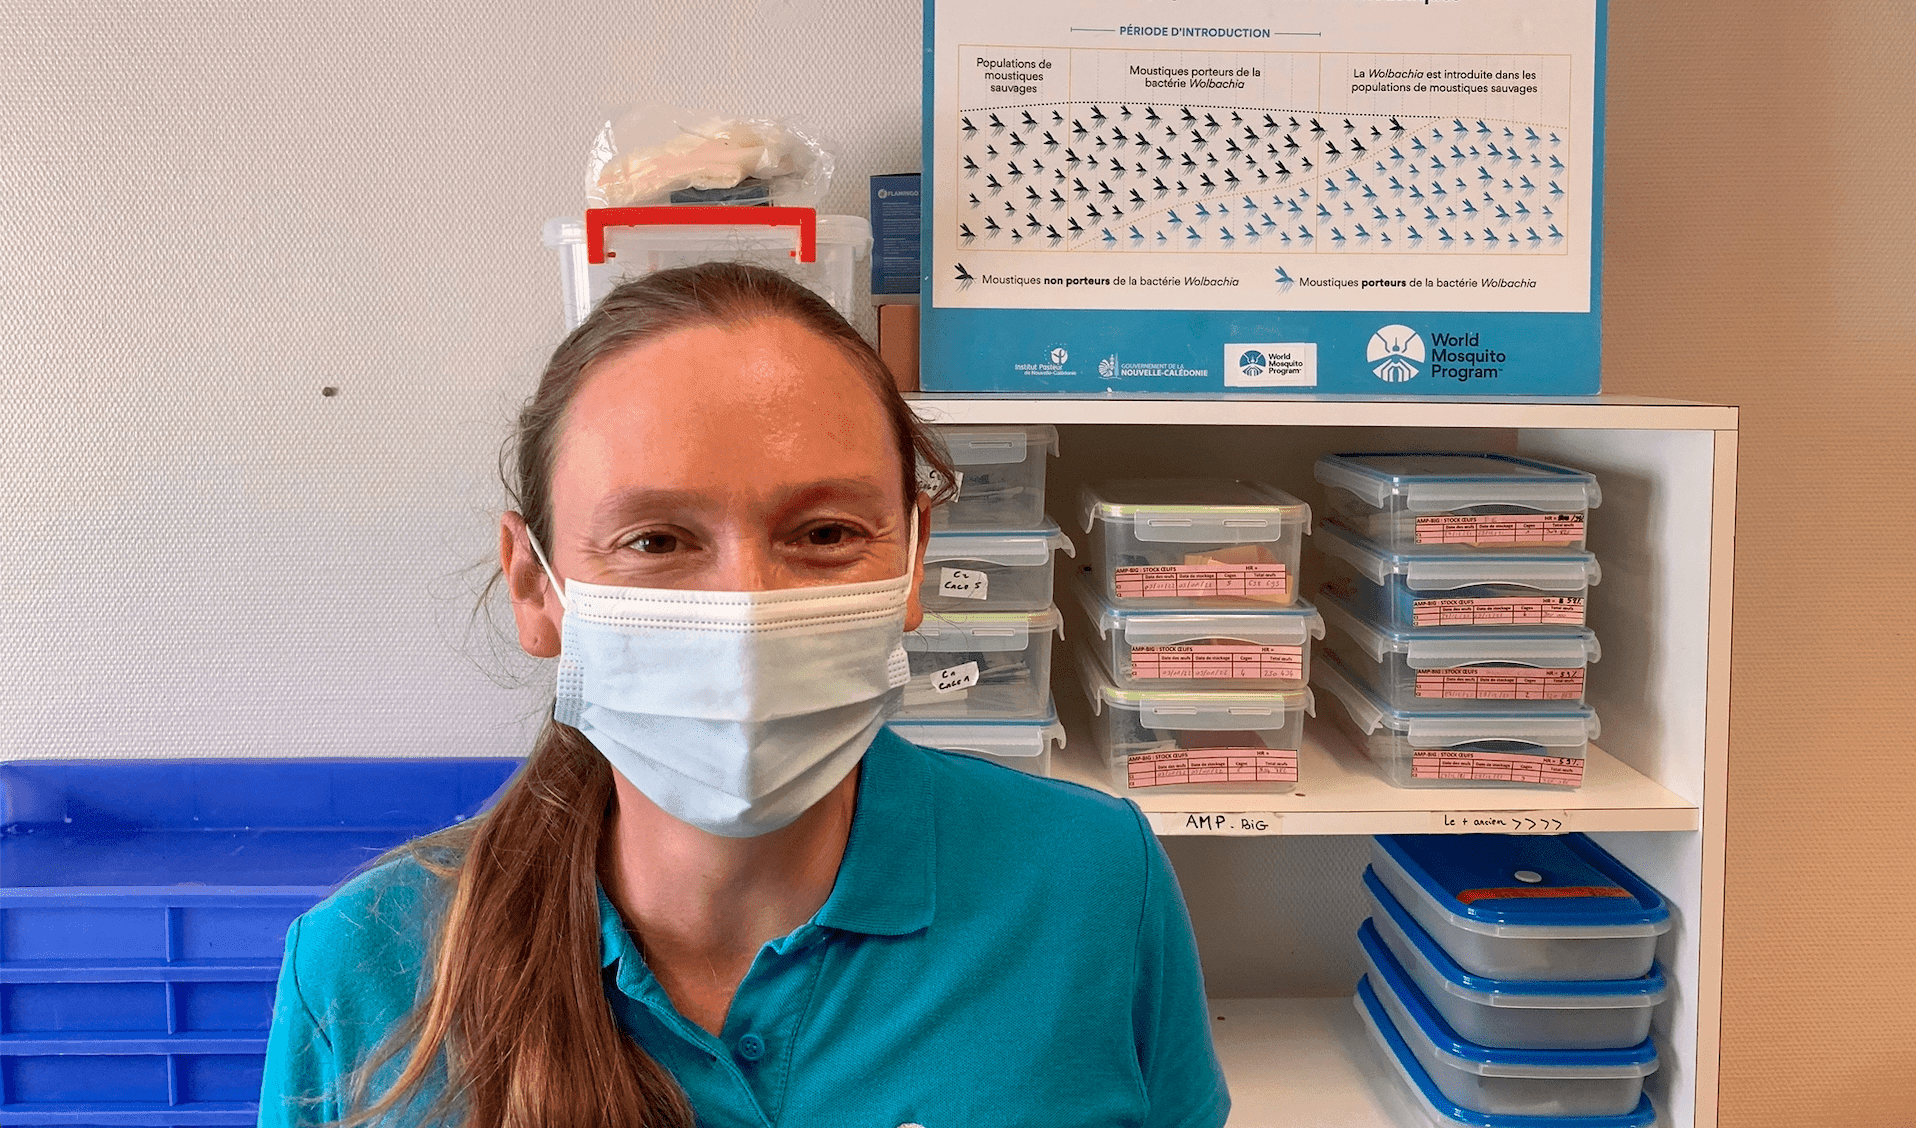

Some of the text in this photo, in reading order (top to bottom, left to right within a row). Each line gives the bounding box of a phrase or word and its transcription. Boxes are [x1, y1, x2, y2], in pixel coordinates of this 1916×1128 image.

[1120, 24, 1270, 38] PÉRIODE D'INTRODUCTION
[976, 58, 1052, 70] Populations de
[985, 71, 1044, 83] moustiques
[1130, 66, 1260, 78] Moustiques porteurs de la
[1353, 69, 1536, 80] La Wolbachia est introduite dans les
[990, 84, 1038, 95] sauvages
[1145, 78, 1245, 89] bactérie Wolbachia
[1351, 82, 1538, 95] populations de moustiques sauvages
[982, 275, 1041, 287] Moustiques
[1066, 278, 1110, 287] porteurs
[1113, 276, 1126, 286] de
[1128, 276, 1137, 286] la
[1140, 276, 1181, 286] bactérie
[1184, 276, 1239, 286] Wolbachia
[1300, 278, 1536, 289] Moustiques porteurs de la bactérie Wolbachia
[1431, 332, 1479, 347] World
[1431, 349, 1506, 365] Mosquito
[1121, 368, 1208, 377] NOUVELLE-CALÉDONIE
[1186, 815, 1225, 830] AMP
[1445, 814, 1455, 826] Le
[1474, 818, 1506, 826] ancien
